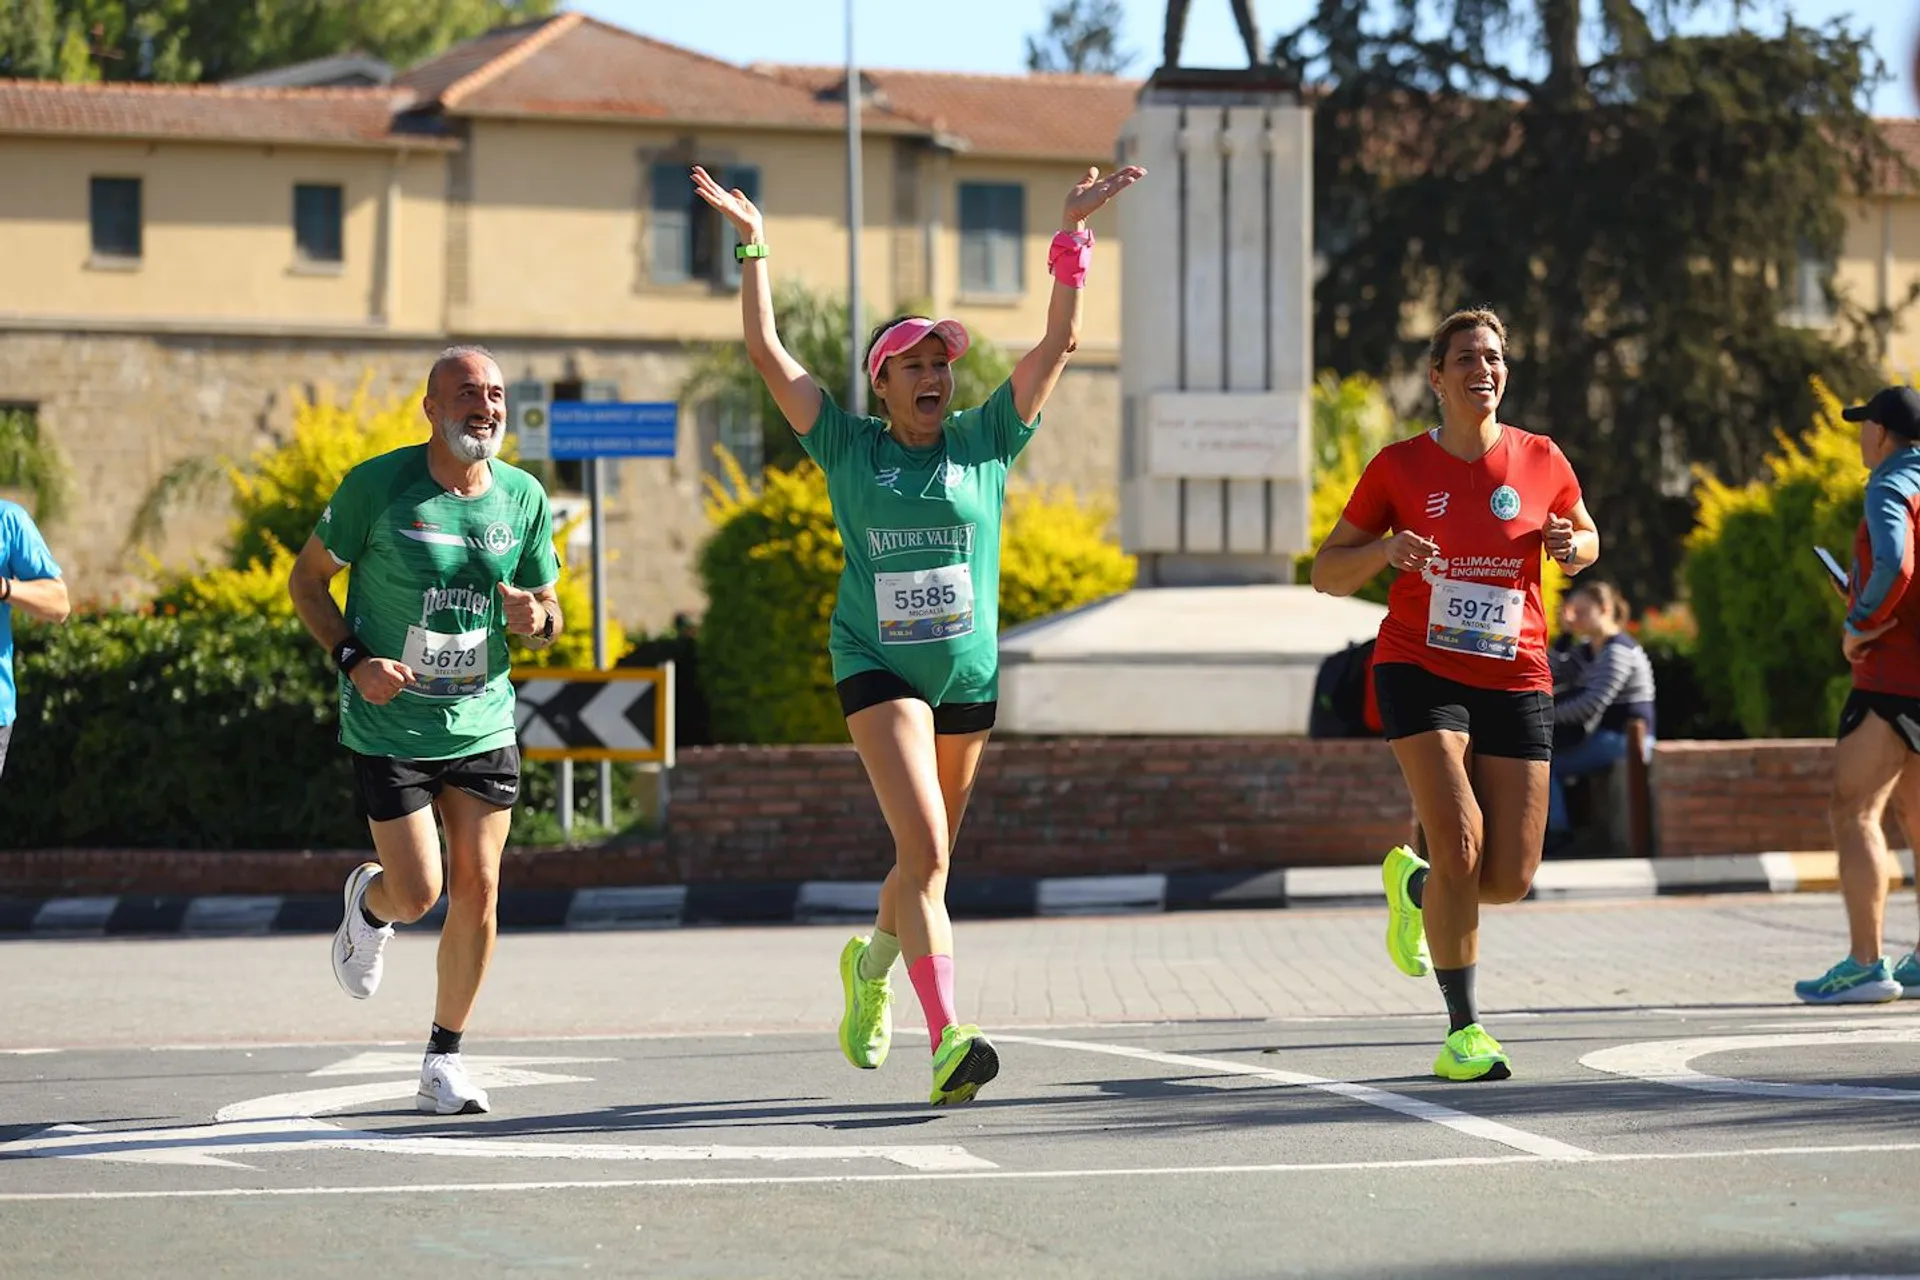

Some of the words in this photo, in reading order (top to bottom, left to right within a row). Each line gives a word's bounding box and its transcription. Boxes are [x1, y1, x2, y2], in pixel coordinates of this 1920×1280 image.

[869, 531, 924, 556] NATURE
[926, 526, 974, 554] VALLEY
[1451, 557, 1524, 568] CLIMACARE
[1451, 568, 1519, 578] ENGINEERING
[894, 584, 956, 610] 5585
[1447, 597, 1506, 624] 5971
[1461, 619, 1491, 630] ANTONIS
[420, 648, 476, 668] 5673
